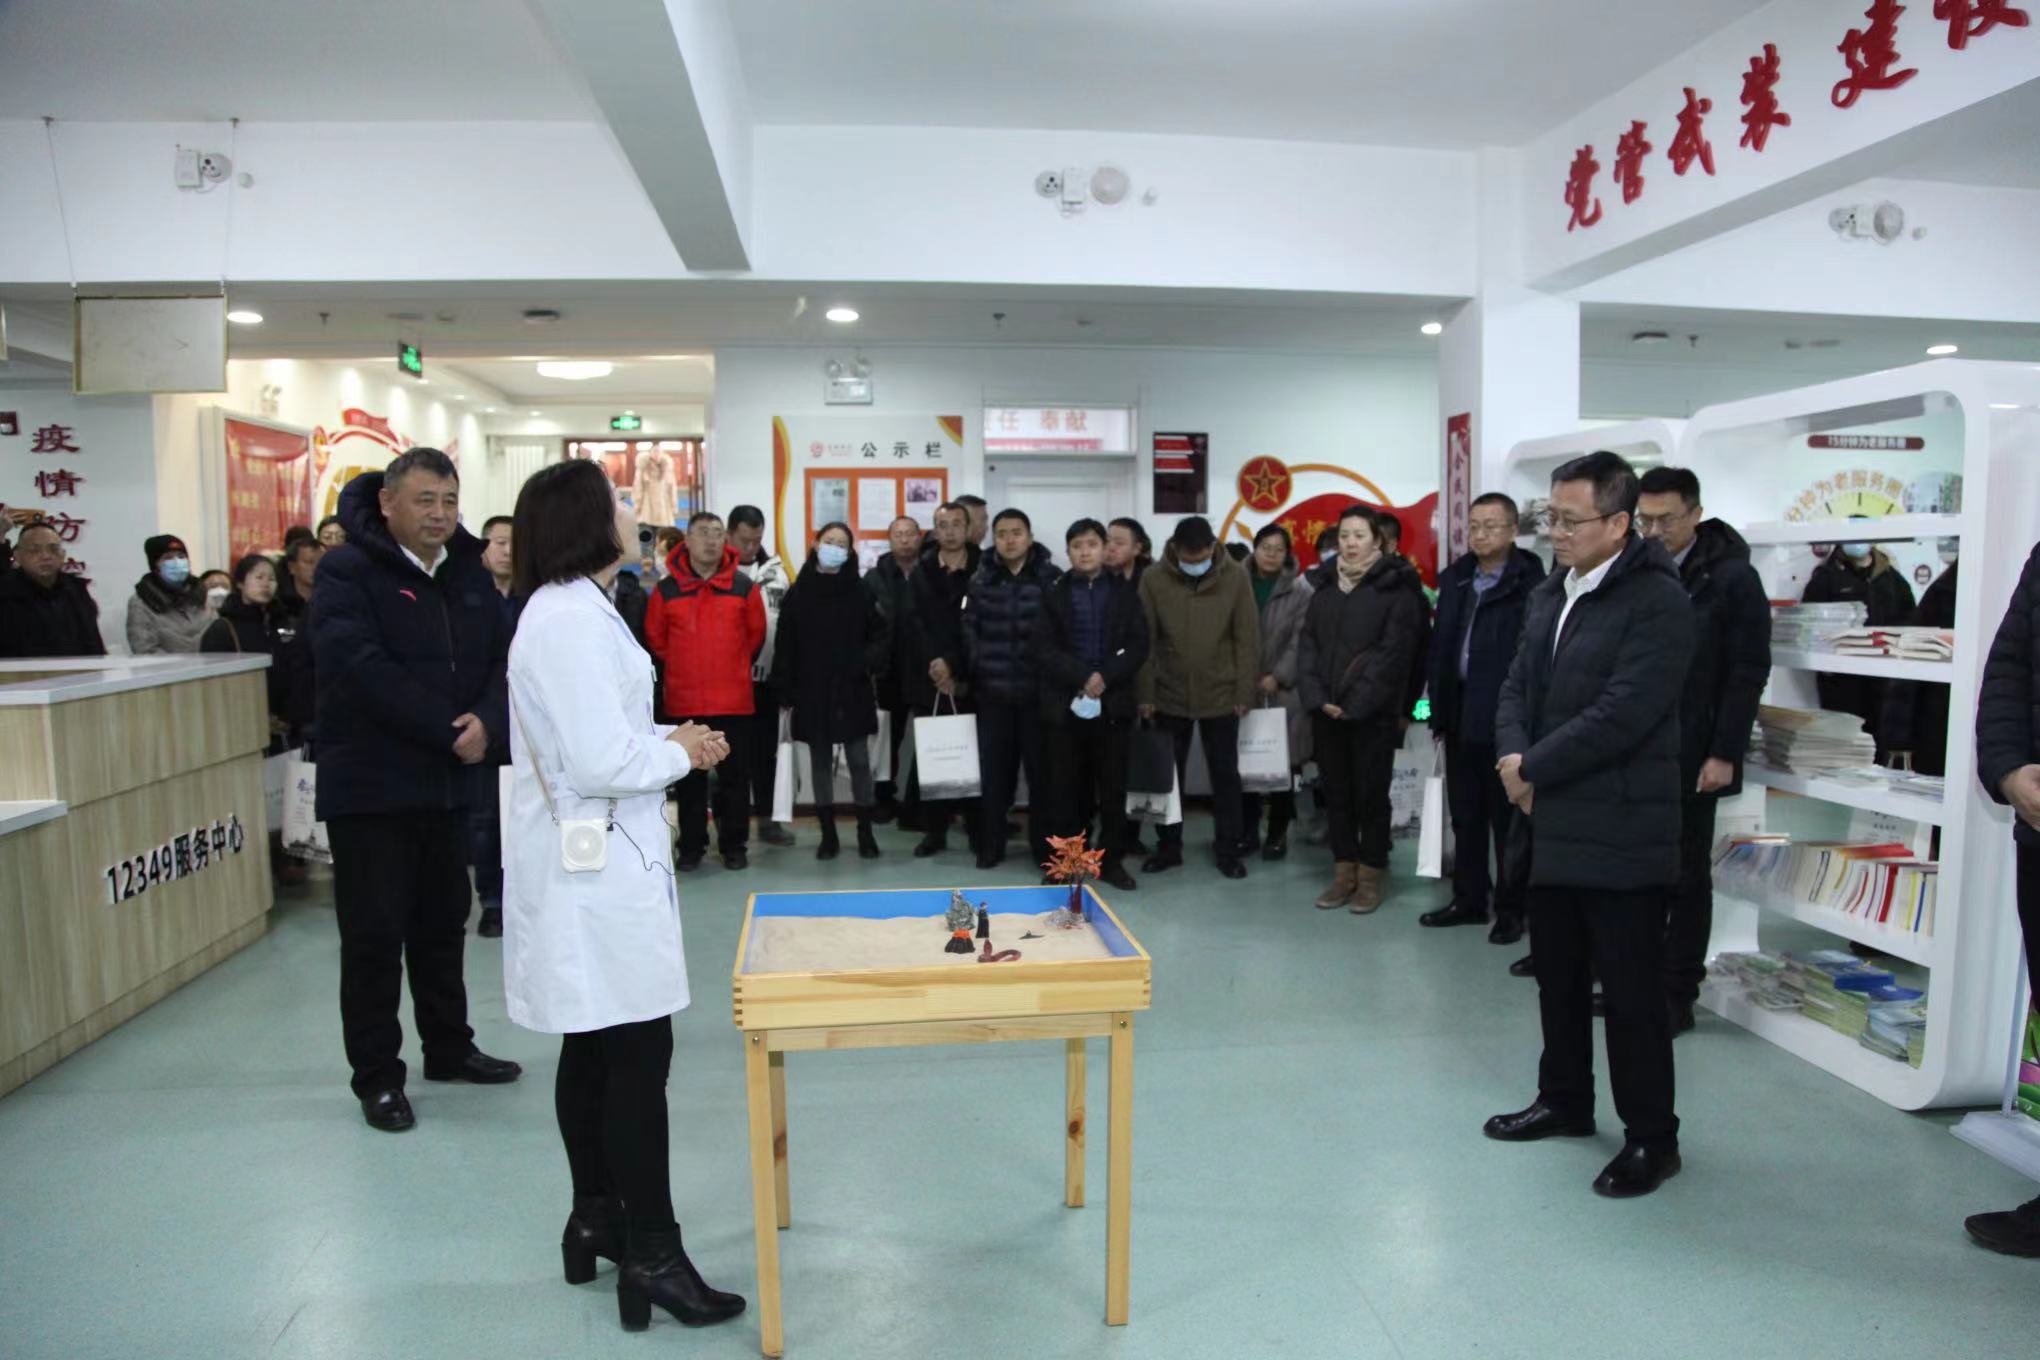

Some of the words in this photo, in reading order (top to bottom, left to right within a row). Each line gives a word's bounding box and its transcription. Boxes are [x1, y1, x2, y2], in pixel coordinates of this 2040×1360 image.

[861, 441, 942, 459] 公示栏
[104, 813, 244, 905] 12349服务中心
